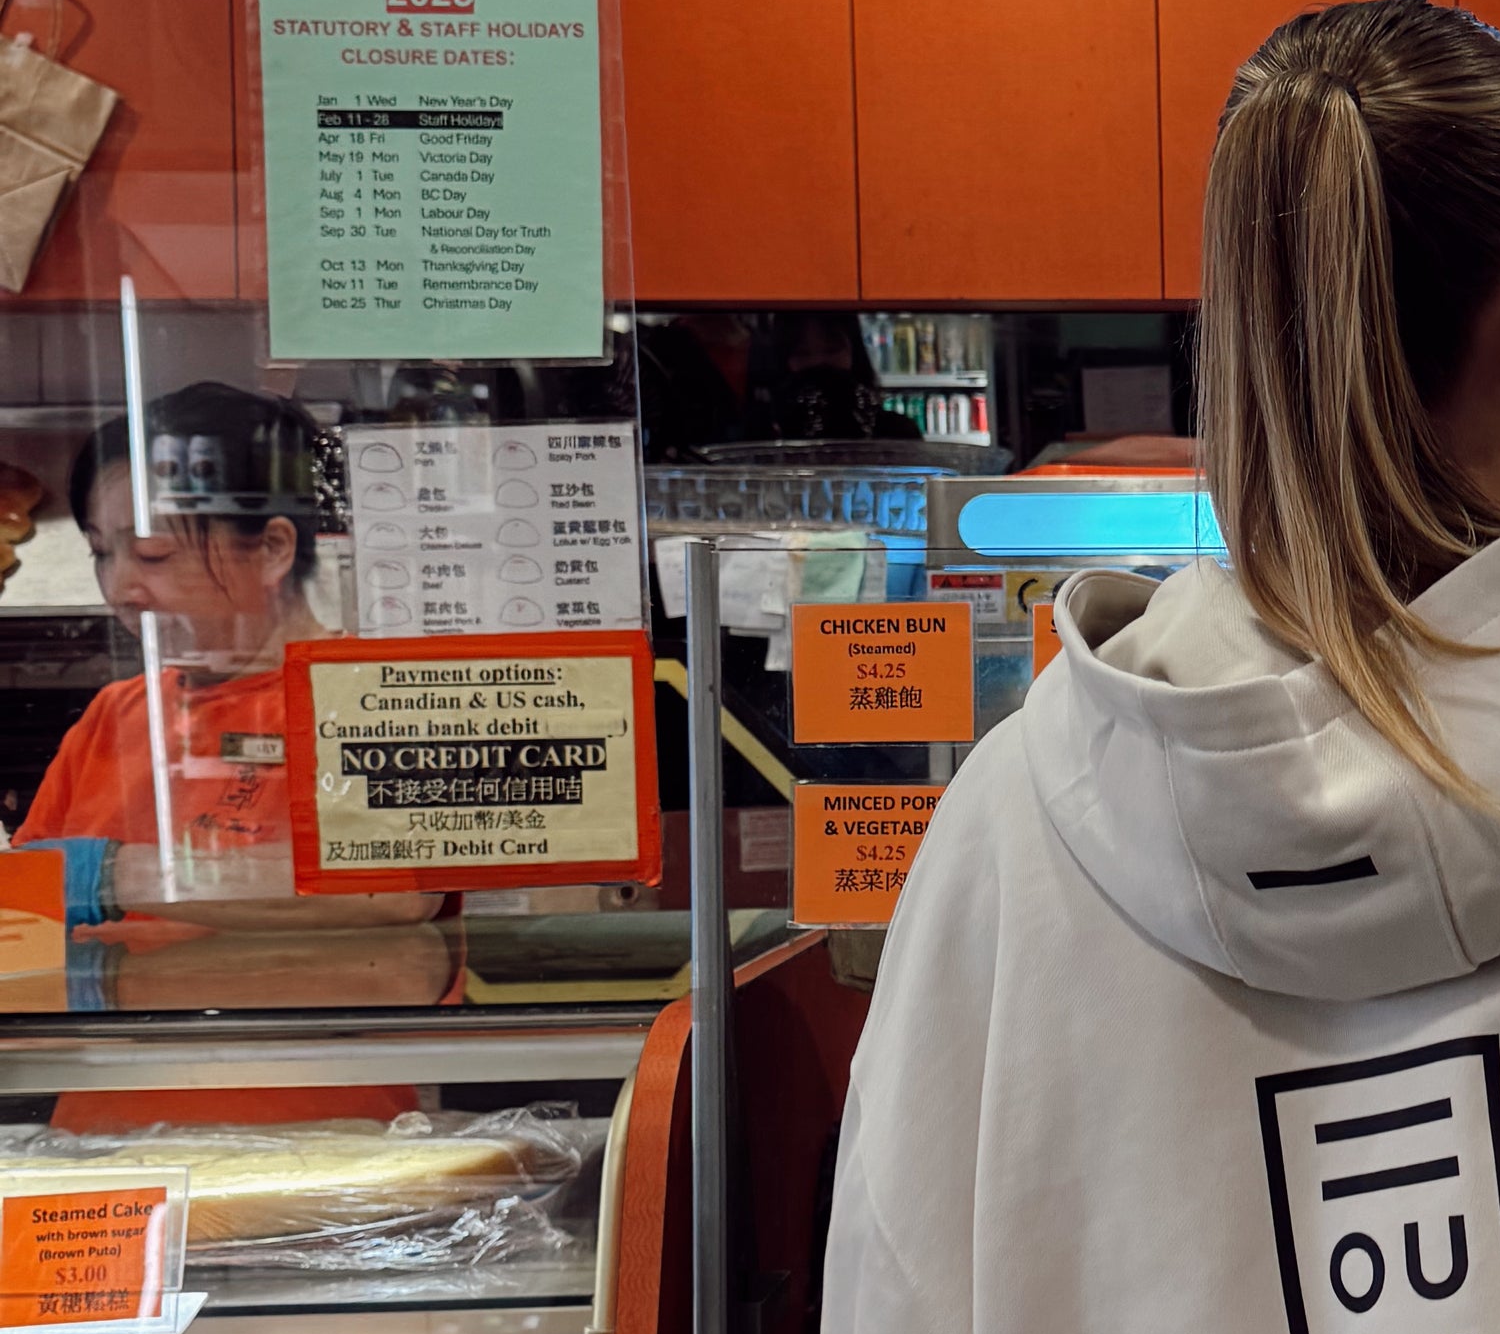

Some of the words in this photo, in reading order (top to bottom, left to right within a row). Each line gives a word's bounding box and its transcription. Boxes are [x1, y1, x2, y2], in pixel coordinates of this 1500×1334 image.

[273, 19, 391, 37] STATUTORY
[397, 19, 414, 38] &
[420, 22, 481, 38] STAFF
[488, 22, 585, 39] HOLIDAYS
[341, 49, 438, 66] CLOSURE
[444, 49, 515, 66] DATES:
[317, 94, 338, 107] Jan
[367, 95, 397, 107] Wed
[418, 95, 449, 107] New
[489, 96, 514, 110] Day
[318, 114, 341, 126] Feb
[418, 114, 449, 126] Staff
[450, 114, 503, 128] Holidays
[318, 132, 340, 145] Apr
[350, 132, 365, 144] 18
[369, 132, 385, 144] Fri
[419, 133, 453, 145] Good
[318, 151, 345, 165] May
[349, 151, 364, 163] 19
[372, 151, 400, 163] Mon
[419, 151, 467, 164] Victoria
[469, 151, 493, 166] Day
[319, 170, 343, 184] July
[371, 170, 395, 182] Tue
[419, 170, 468, 183] Canada
[470, 170, 495, 185] Day
[421, 188, 440, 201] BC
[443, 188, 467, 203] Day
[421, 207, 463, 219] Labour
[466, 207, 490, 221] Day
[320, 225, 345, 239] Sep
[350, 226, 366, 238] 30
[374, 226, 397, 238] Tue
[421, 226, 473, 238] National
[475, 226, 500, 240] Day
[501, 226, 518, 238] for
[520, 226, 551, 238] Truth
[422, 296, 487, 309] Christmas
[488, 297, 512, 312] Day
[819, 618, 901, 635] CHICKEN
[905, 617, 946, 634] BUN
[848, 641, 917, 657] (Steamed)
[380, 665, 472, 686] Payment
[478, 663, 563, 685] options:
[855, 662, 907, 681] $4.25
[360, 692, 461, 712] Canadian
[468, 693, 488, 709] &
[496, 691, 526, 709] US
[532, 690, 586, 710] cash,
[848, 685, 923, 711] 蒸雞飽
[319, 721, 419, 740] Canadian
[427, 719, 480, 737] bank
[486, 718, 539, 737] debit
[343, 747, 386, 772] NO
[393, 744, 512, 770] CREDIT
[519, 743, 606, 768] CARD
[368, 775, 583, 805] 不接受任何信用咭
[823, 795, 896, 811] MINCED
[900, 795, 941, 811] POR
[823, 820, 839, 836] &
[442, 838, 494, 856] Debit
[500, 837, 549, 855] Card
[855, 844, 906, 862] $4.25
[32, 1203, 108, 1225] Steamed
[112, 1201, 154, 1219] Cake
[36, 1230, 64, 1243] with
[67, 1229, 108, 1242] brown
[111, 1226, 146, 1242] sugar
[39, 1247, 85, 1264] (Brown
[88, 1244, 122, 1260] Puto)
[55, 1265, 108, 1286] $3.00
